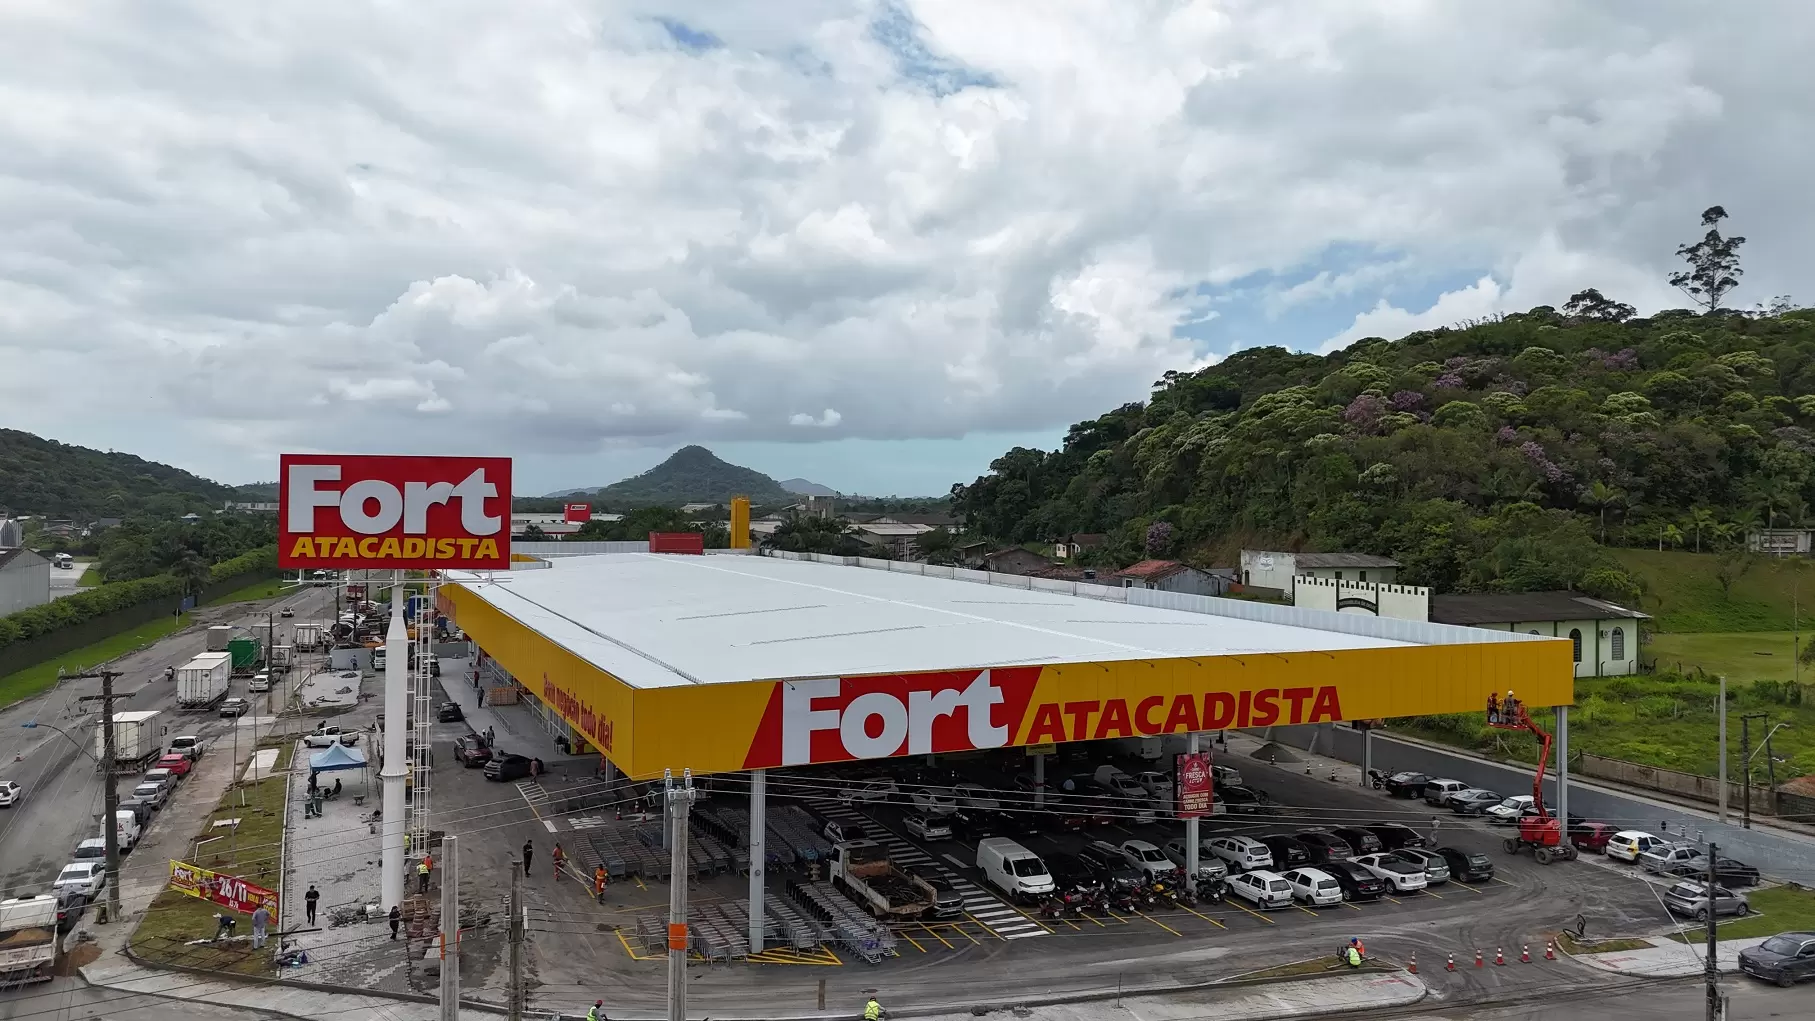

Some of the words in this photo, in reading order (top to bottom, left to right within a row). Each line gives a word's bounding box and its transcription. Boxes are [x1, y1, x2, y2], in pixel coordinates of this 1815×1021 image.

[288, 464, 502, 536] Fort
[290, 537, 500, 559] ATACADISTA
[581, 699, 596, 738] todo
[598, 713, 612, 753] dia!
[782, 669, 1008, 765] Fort
[1025, 686, 1342, 745] ATACADISTA
[1185, 771, 1206, 779] FRESCA
[219, 876, 247, 902] 26/11
